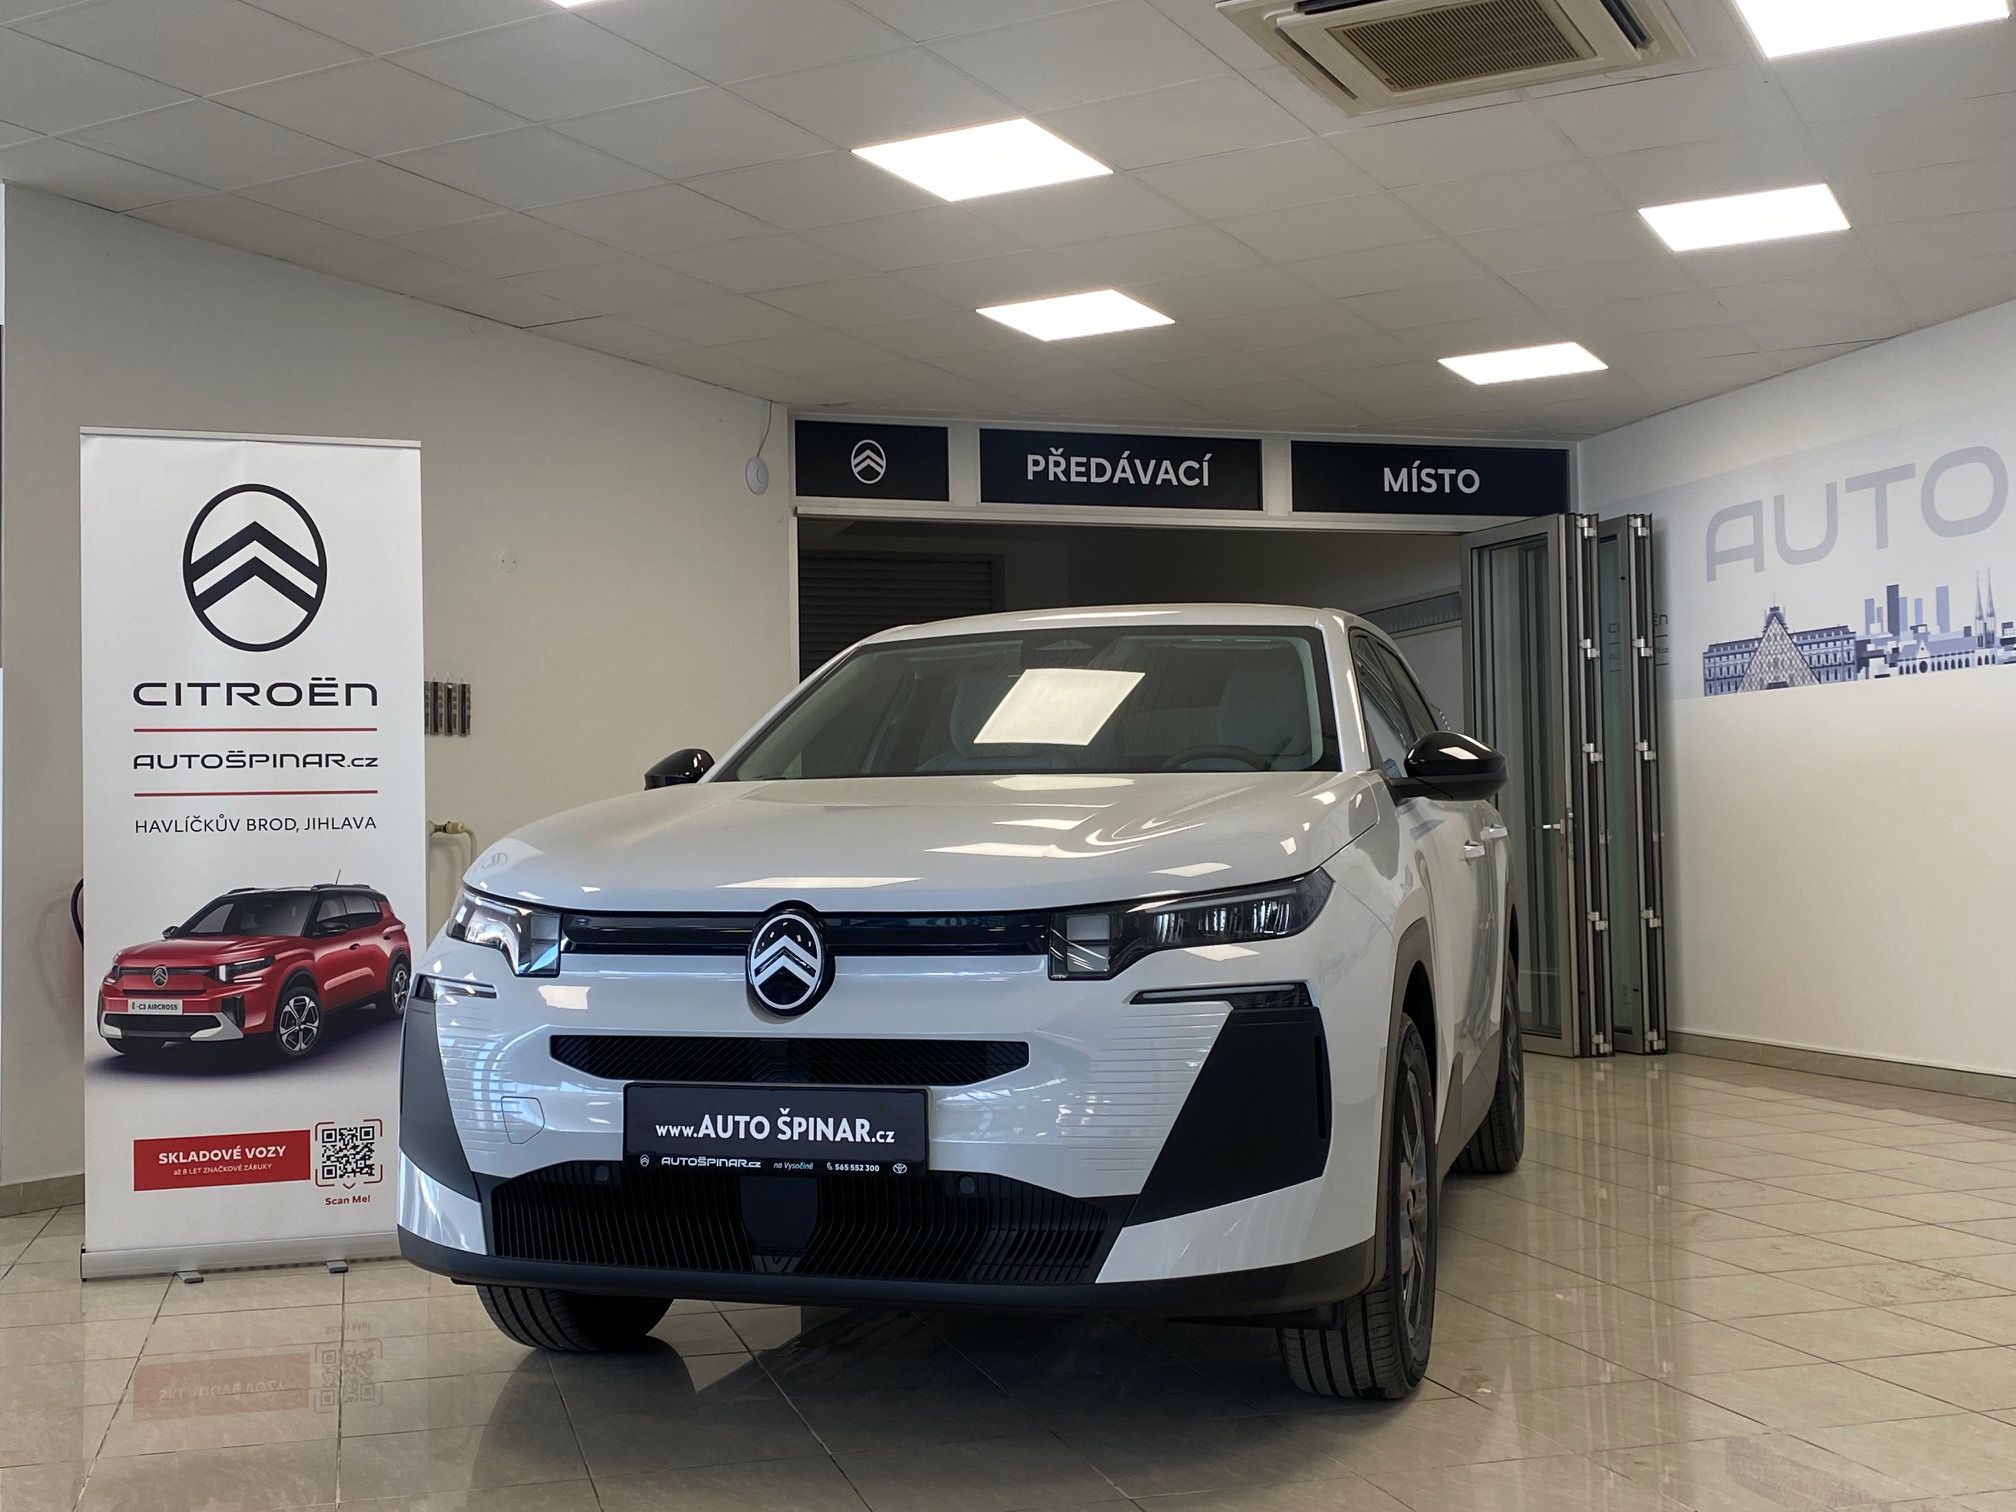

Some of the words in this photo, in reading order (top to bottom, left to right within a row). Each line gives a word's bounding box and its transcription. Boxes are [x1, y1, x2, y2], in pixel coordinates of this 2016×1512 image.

[1027, 447, 1212, 487] PŘEDÁVACÍ
[1383, 460, 1480, 494] MÍSTO
[1706, 446, 2008, 582] AUTO
[133, 676, 378, 707] CITROËN
[135, 814, 240, 833] HAVLÍČKŮV
[246, 818, 300, 834] BROD,
[304, 816, 377, 832] JIHLAVA
[147, 1003, 178, 1011] AIRCROSS
[655, 1113, 770, 1140] www.AUTO
[776, 1107, 895, 1143] ŠPINAR.cz
[158, 1145, 242, 1164] SKLADOVÉ
[245, 1145, 286, 1159] VOZY
[188, 1167, 202, 1175] LET
[203, 1164, 242, 1174] ZNAČKOVÉ
[243, 1163, 272, 1171] ZÁRUKY
[834, 1163, 849, 1171] 565
[850, 1163, 864, 1172] 552
[864, 1164, 880, 1172] 300
[325, 1197, 350, 1206] Scan
[352, 1194, 371, 1204] Me!
